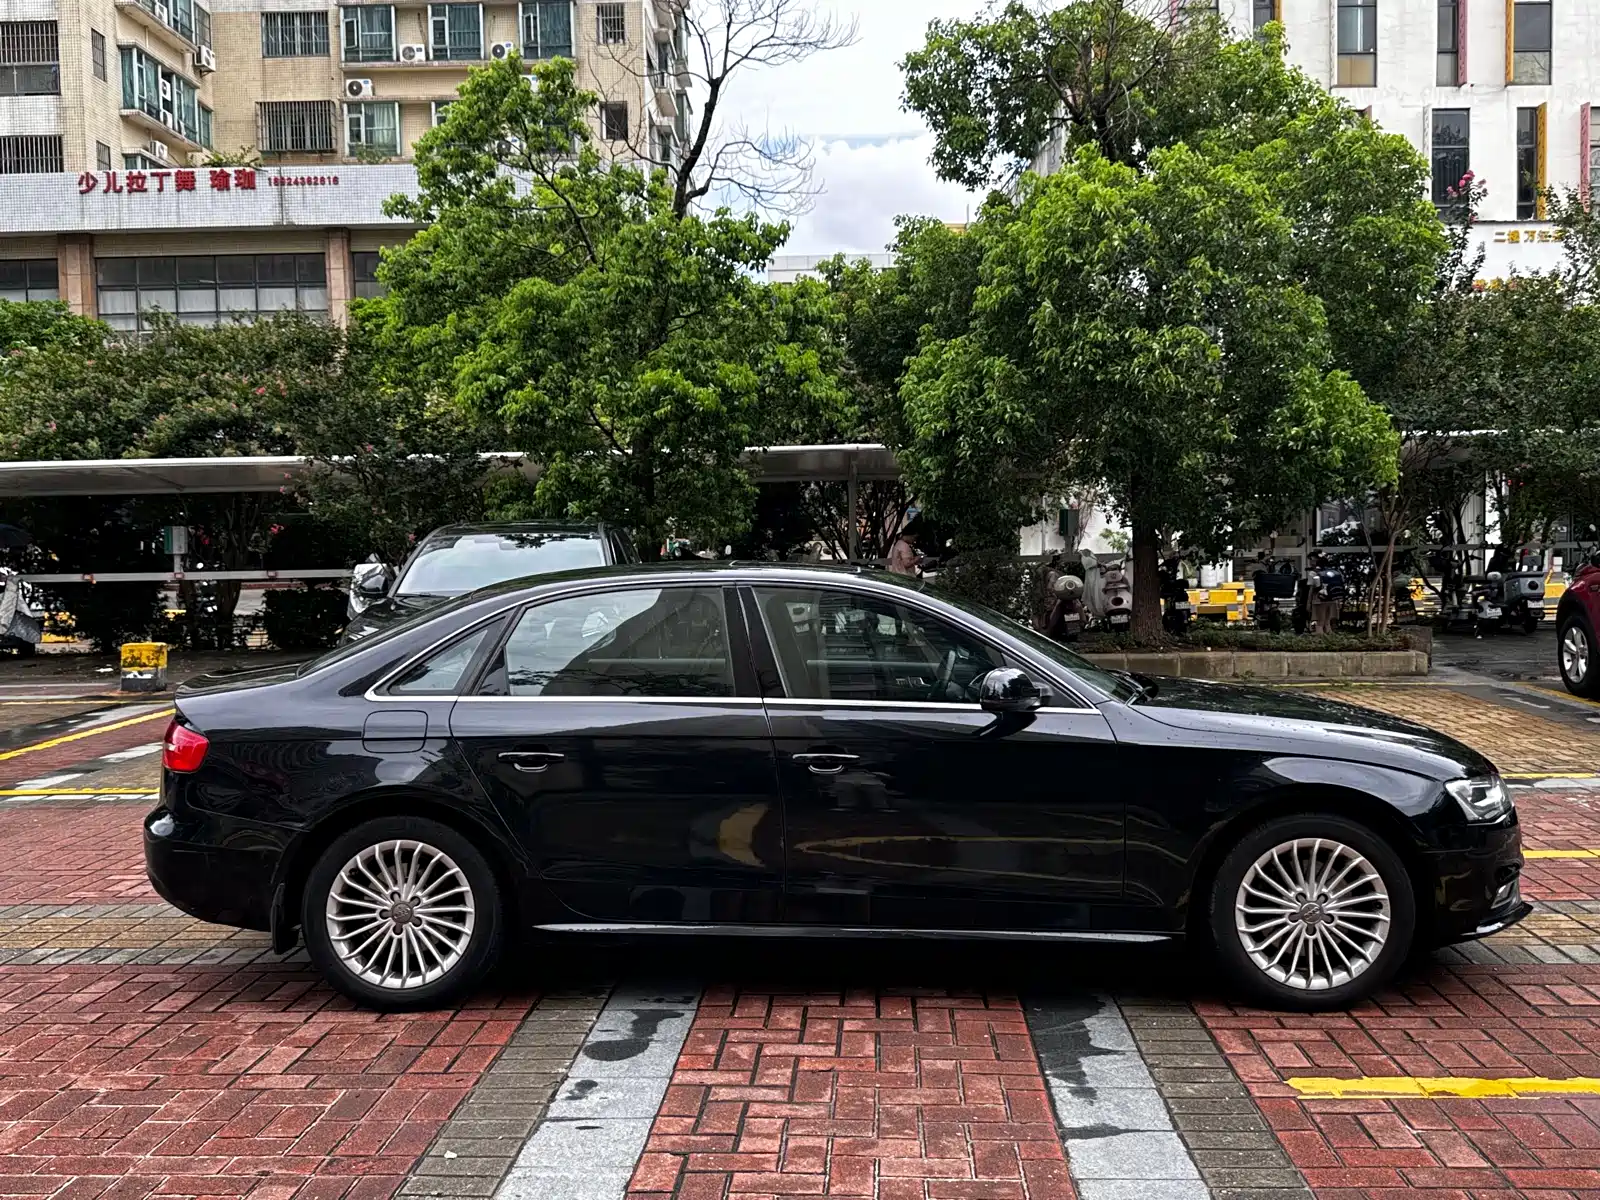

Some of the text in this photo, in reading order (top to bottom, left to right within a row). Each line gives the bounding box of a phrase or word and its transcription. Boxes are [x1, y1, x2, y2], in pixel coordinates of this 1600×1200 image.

[78, 169, 196, 194] 少儿拉丁舞
